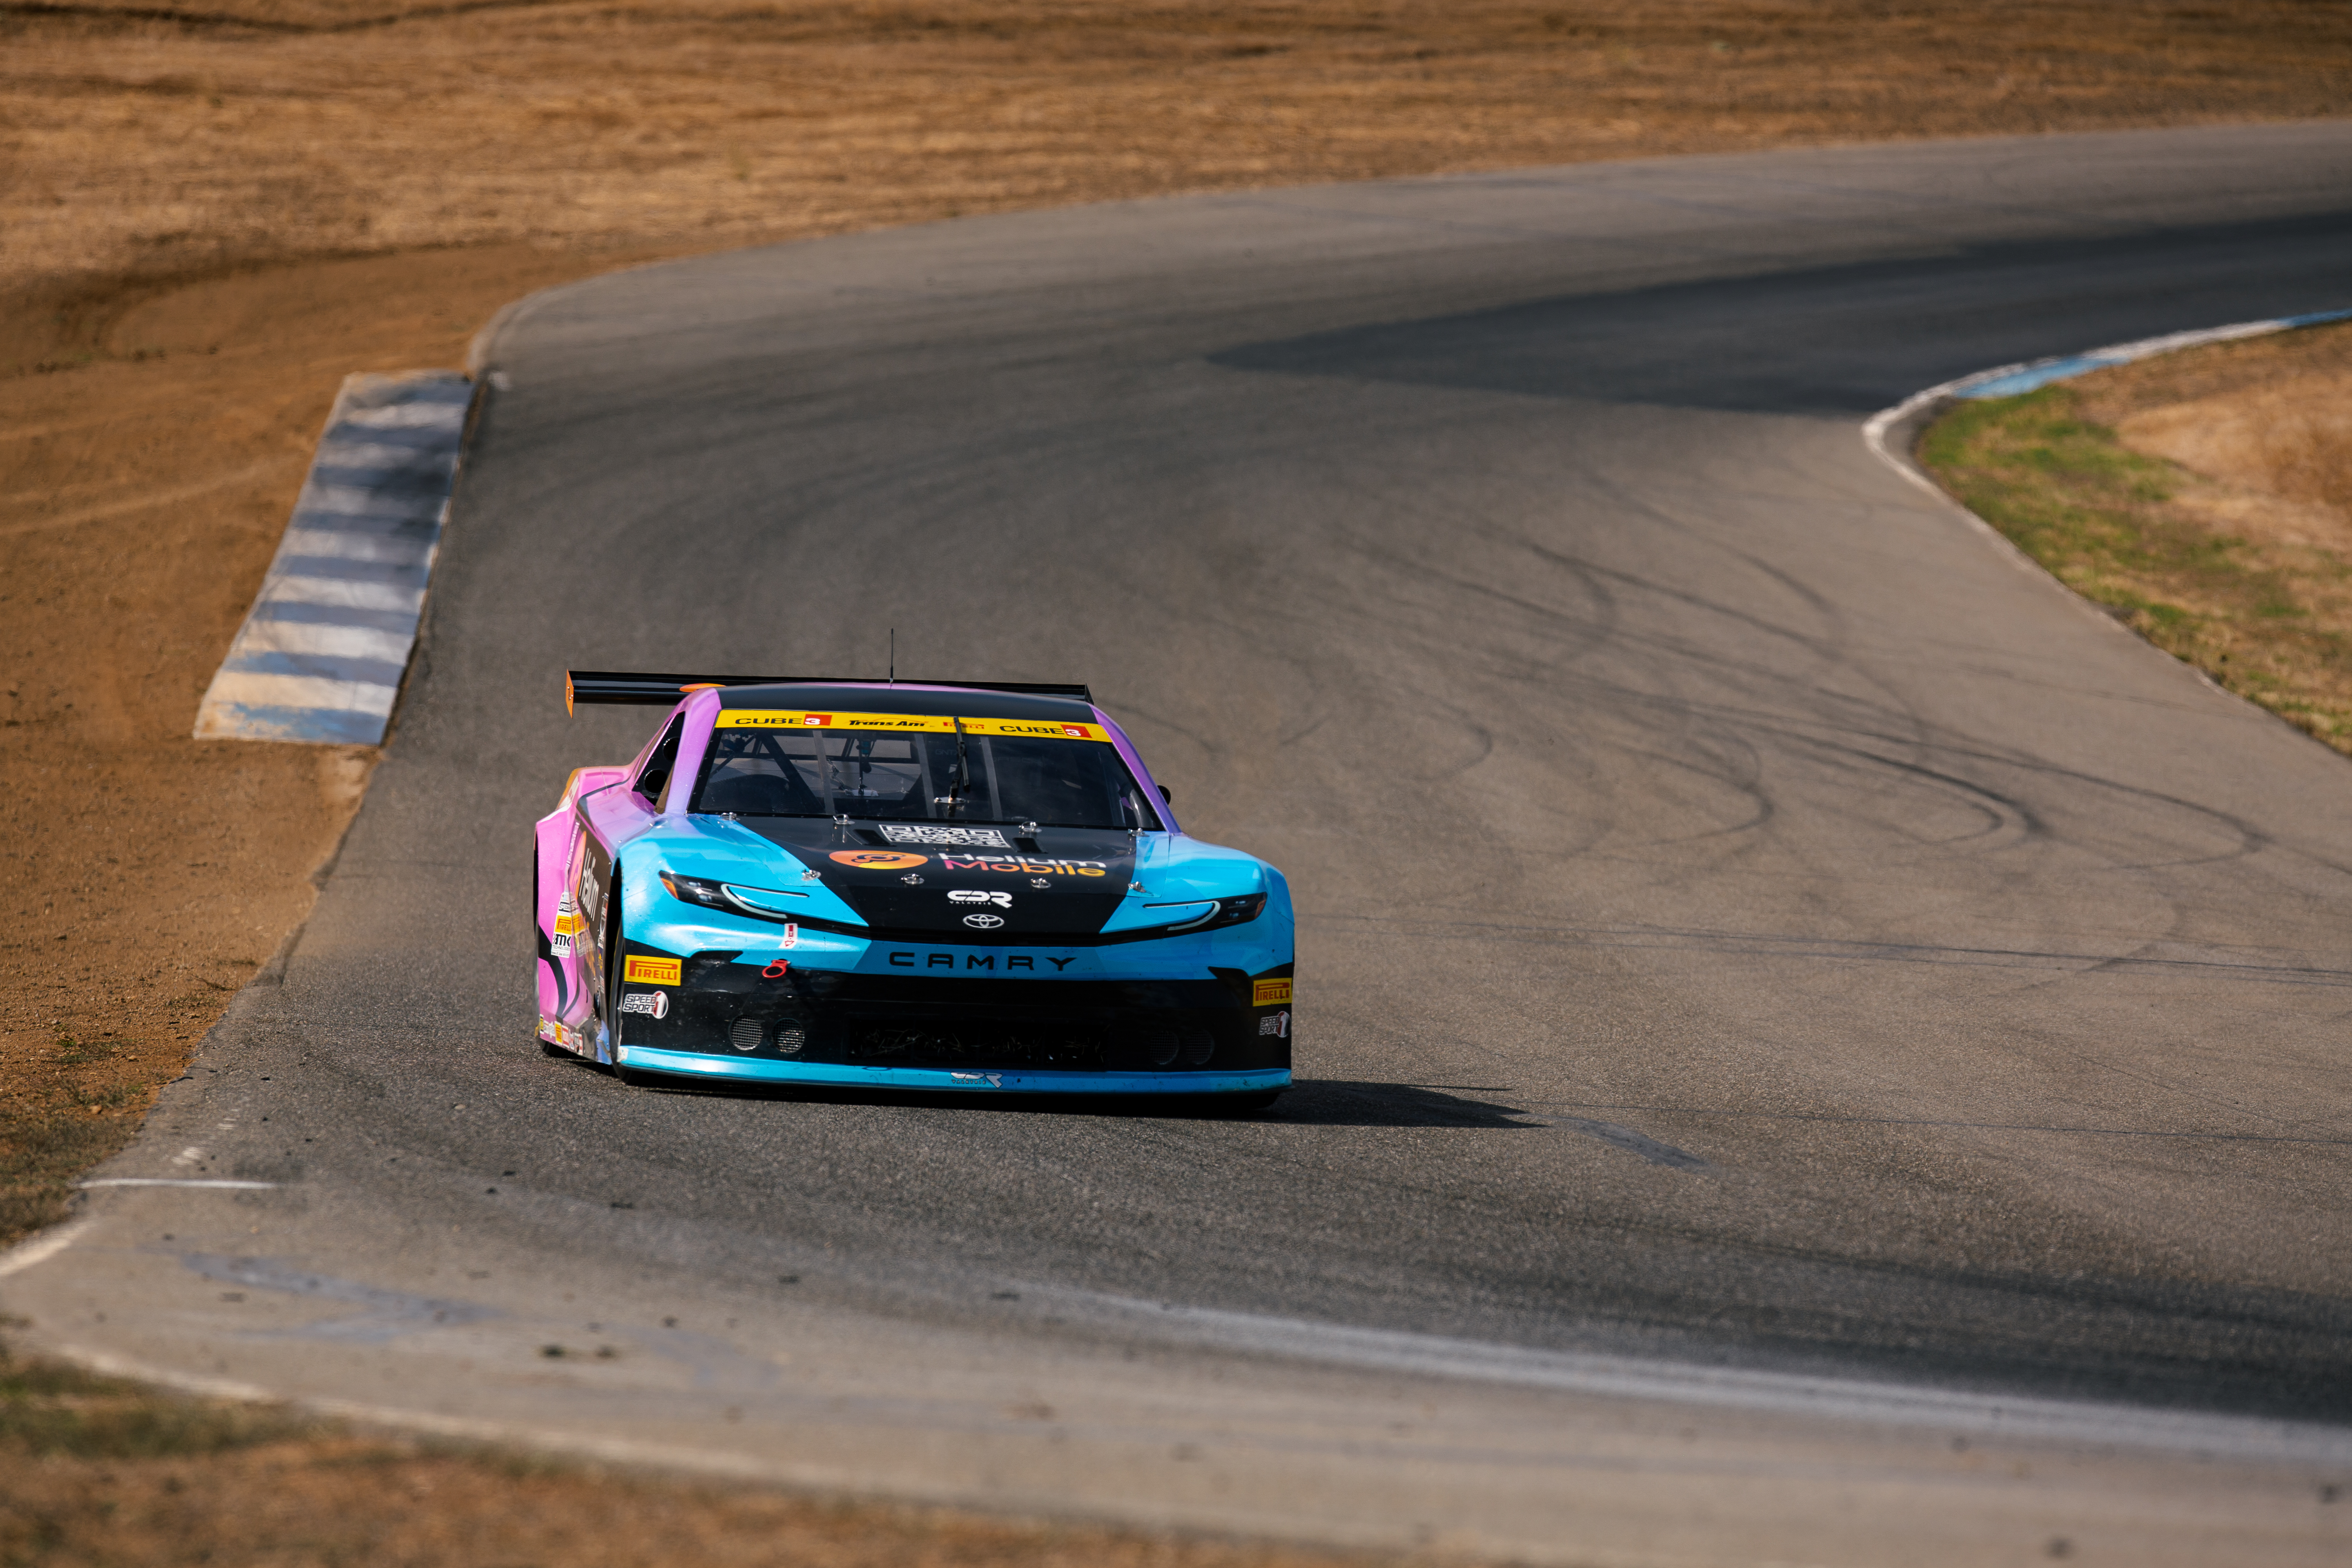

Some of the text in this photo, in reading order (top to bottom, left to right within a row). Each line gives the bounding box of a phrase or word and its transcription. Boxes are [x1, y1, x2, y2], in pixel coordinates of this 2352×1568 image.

[938, 853, 1107, 868] Helium
[943, 860, 1106, 877] Mobile
[889, 952, 1078, 971] CAMRY
[629, 960, 678, 980] PIRELLI
[1255, 982, 1290, 1001] PIRELLI
[626, 995, 657, 1004] SPEED
[624, 1003, 655, 1012] SPORT
[1261, 1016, 1280, 1026] SPEED
[1259, 1025, 1279, 1035] SPORT
